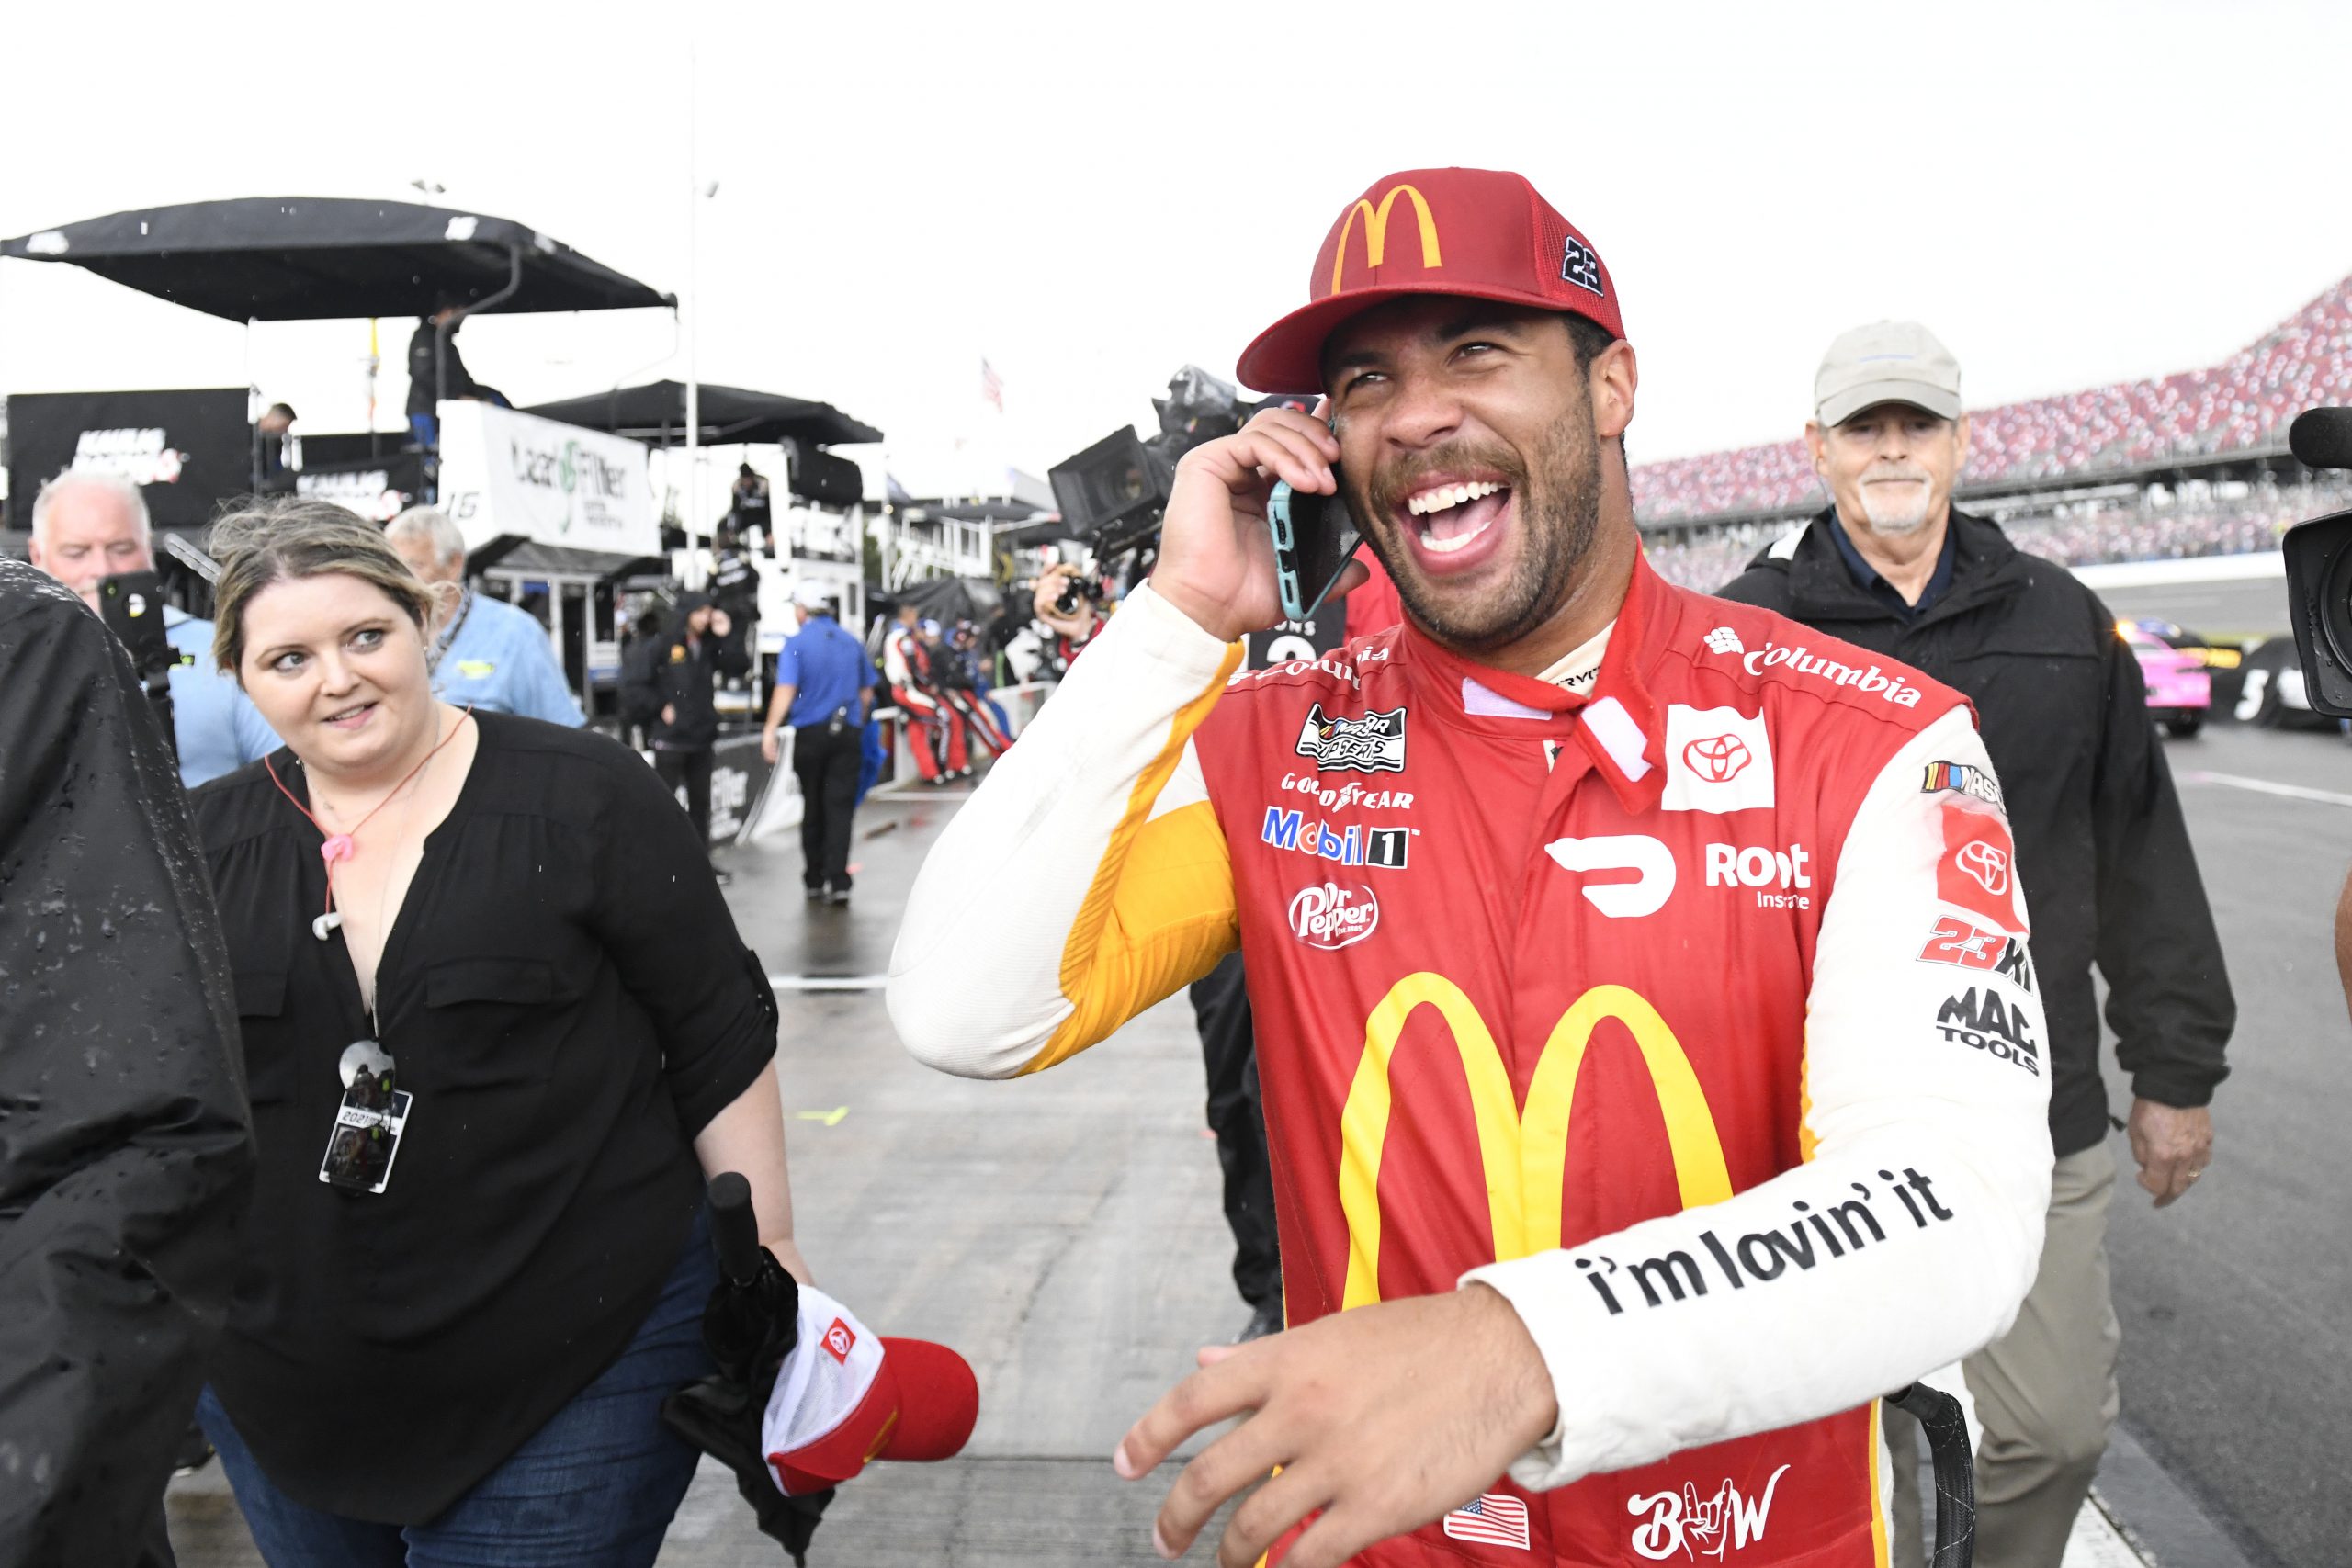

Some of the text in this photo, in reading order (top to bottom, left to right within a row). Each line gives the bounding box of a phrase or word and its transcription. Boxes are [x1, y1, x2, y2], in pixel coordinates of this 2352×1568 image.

[1743, 642, 1922, 708] Columbia
[1261, 805, 1364, 866] Mobil
[1936, 1025, 2040, 1077] TOOLS
[1937, 987, 2039, 1059] MAC
[1574, 1168, 1955, 1315] i'm lovin' it
